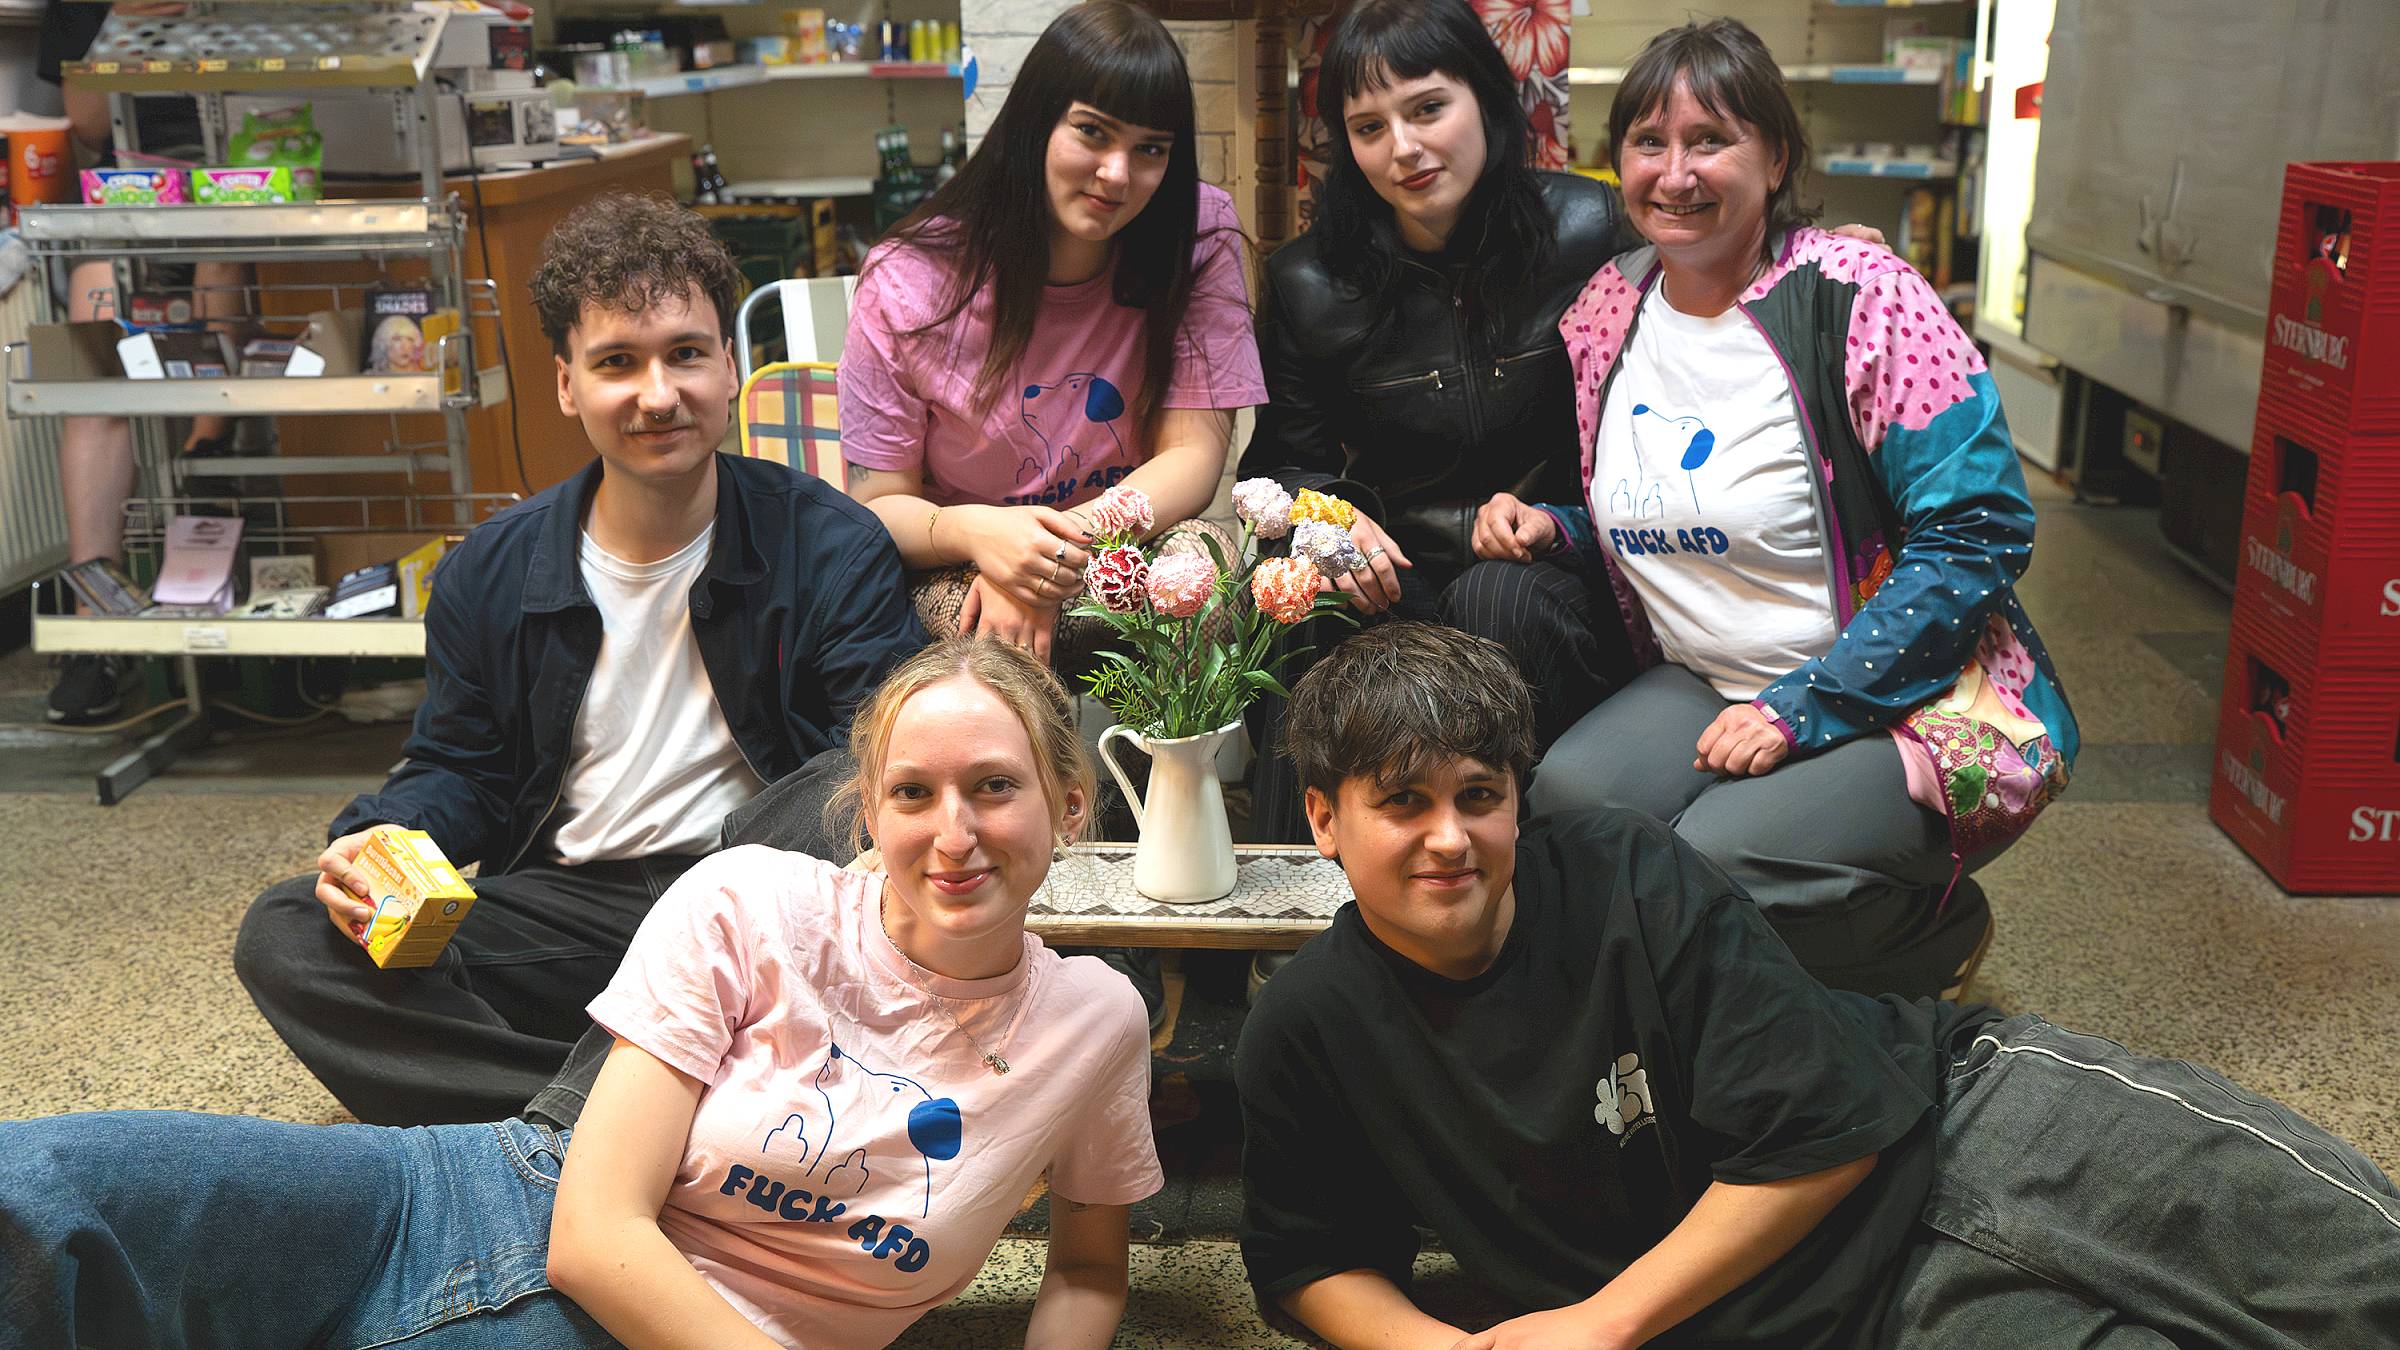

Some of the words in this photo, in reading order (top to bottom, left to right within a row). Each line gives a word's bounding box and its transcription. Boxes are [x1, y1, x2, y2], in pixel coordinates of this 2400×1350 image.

[1609, 528, 1676, 557] FUCK
[1677, 527, 1729, 555] AFD
[2349, 806, 2400, 842] ST
[720, 1164, 847, 1223] FUCK
[848, 1215, 931, 1273] AFD
